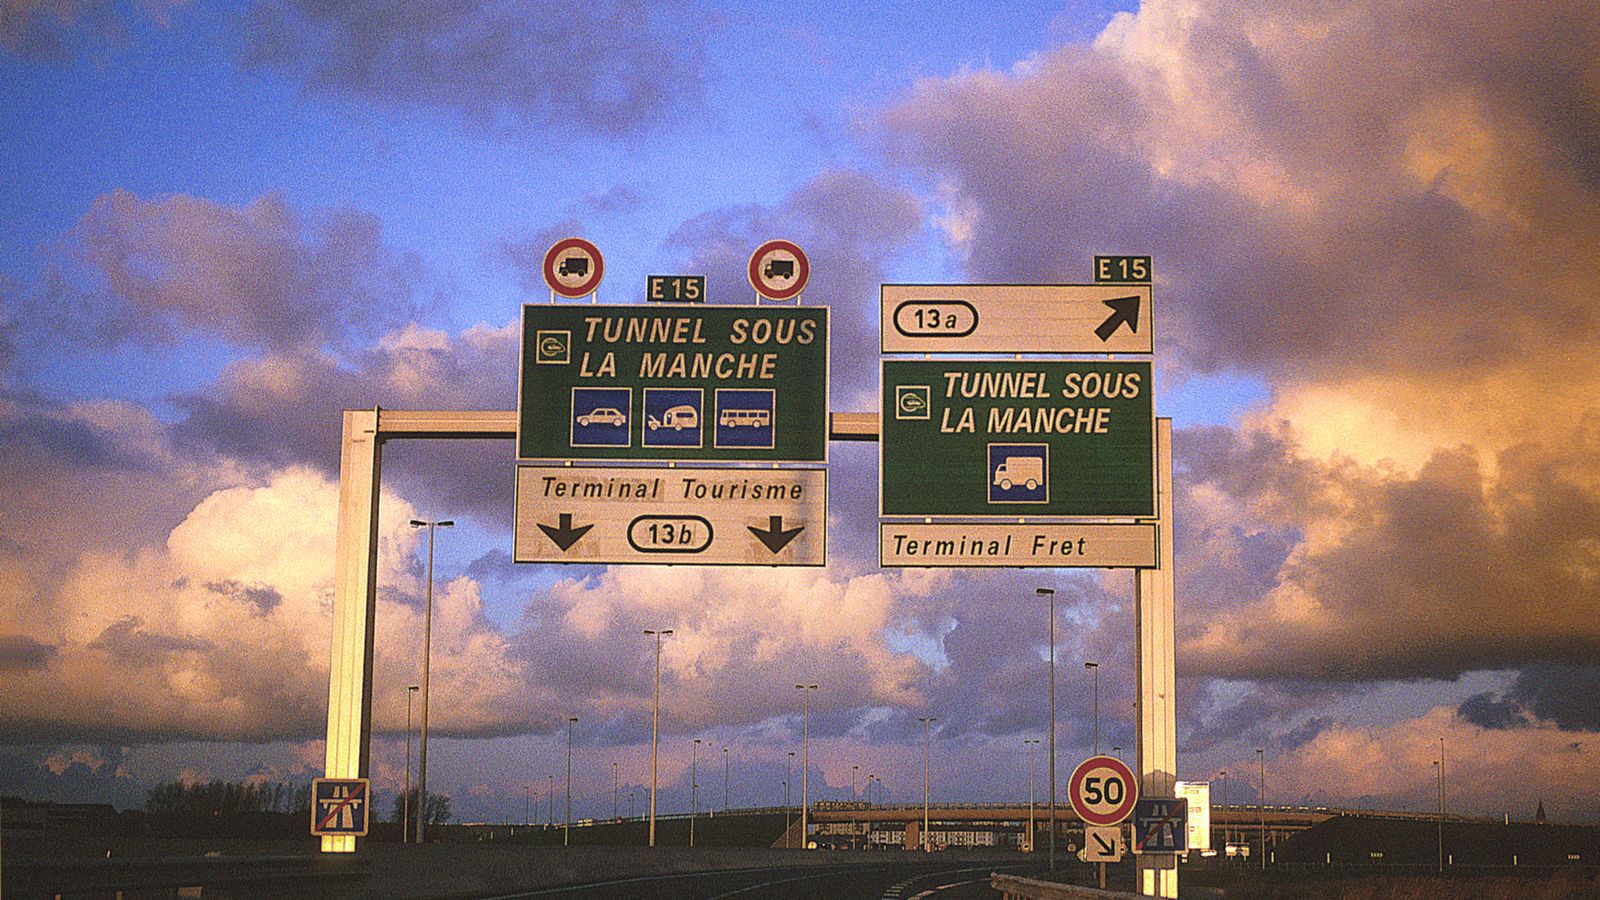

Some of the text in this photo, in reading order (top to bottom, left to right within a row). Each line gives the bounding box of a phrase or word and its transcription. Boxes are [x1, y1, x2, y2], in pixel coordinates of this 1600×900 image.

[1100, 259, 1147, 279] E 15
[652, 278, 700, 299] E 15
[584, 317, 818, 345] TUNNEL SOUS
[914, 309, 958, 329] 13a
[579, 352, 778, 379] LA MANCHE
[943, 372, 1142, 399] TUNNEL SOUS
[940, 407, 1112, 434] LA MANCHE
[541, 476, 803, 500] Terminal Tourisme
[648, 523, 692, 545] 13b
[893, 535, 1087, 556] Terminal Fret
[1084, 777, 1124, 805] 50
